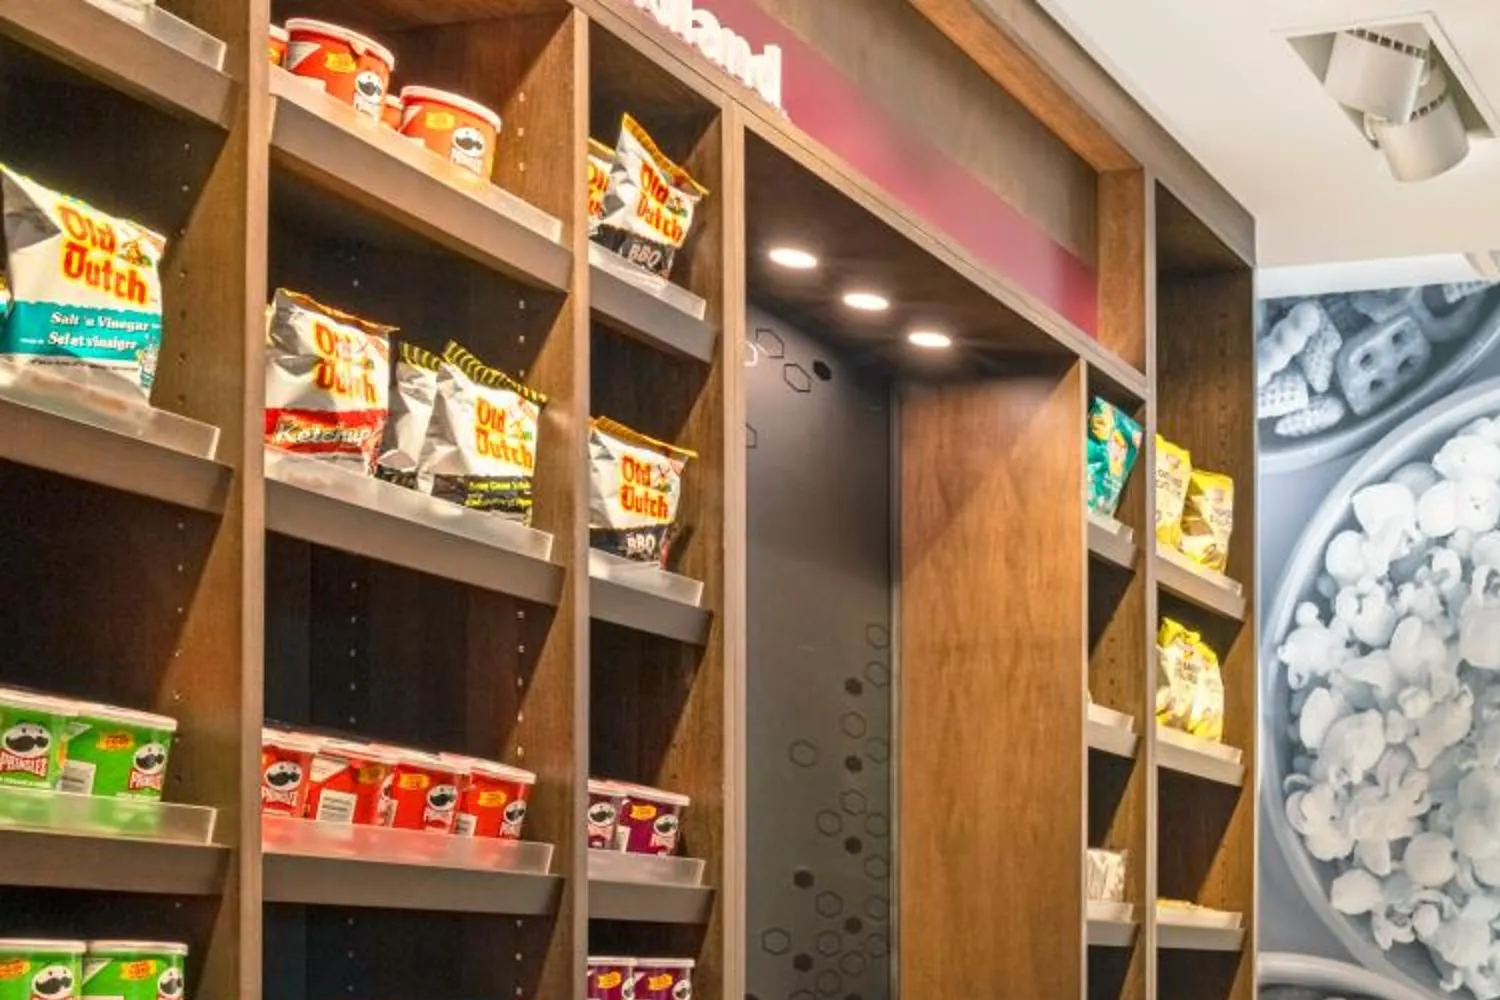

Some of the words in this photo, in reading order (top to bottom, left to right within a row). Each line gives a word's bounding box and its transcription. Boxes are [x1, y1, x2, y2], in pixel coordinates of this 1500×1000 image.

[640, 159, 669, 204] Old
[60, 203, 115, 252] Old
[63, 241, 147, 305] Dutch
[51, 311, 79, 325] Salt
[98, 315, 149, 332] Vinegar
[275, 416, 372, 446] Ketchup
[476, 396, 507, 432] Old
[475, 426, 534, 470] Dutch
[621, 455, 651, 486] Old
[619, 484, 670, 520] Dutch
